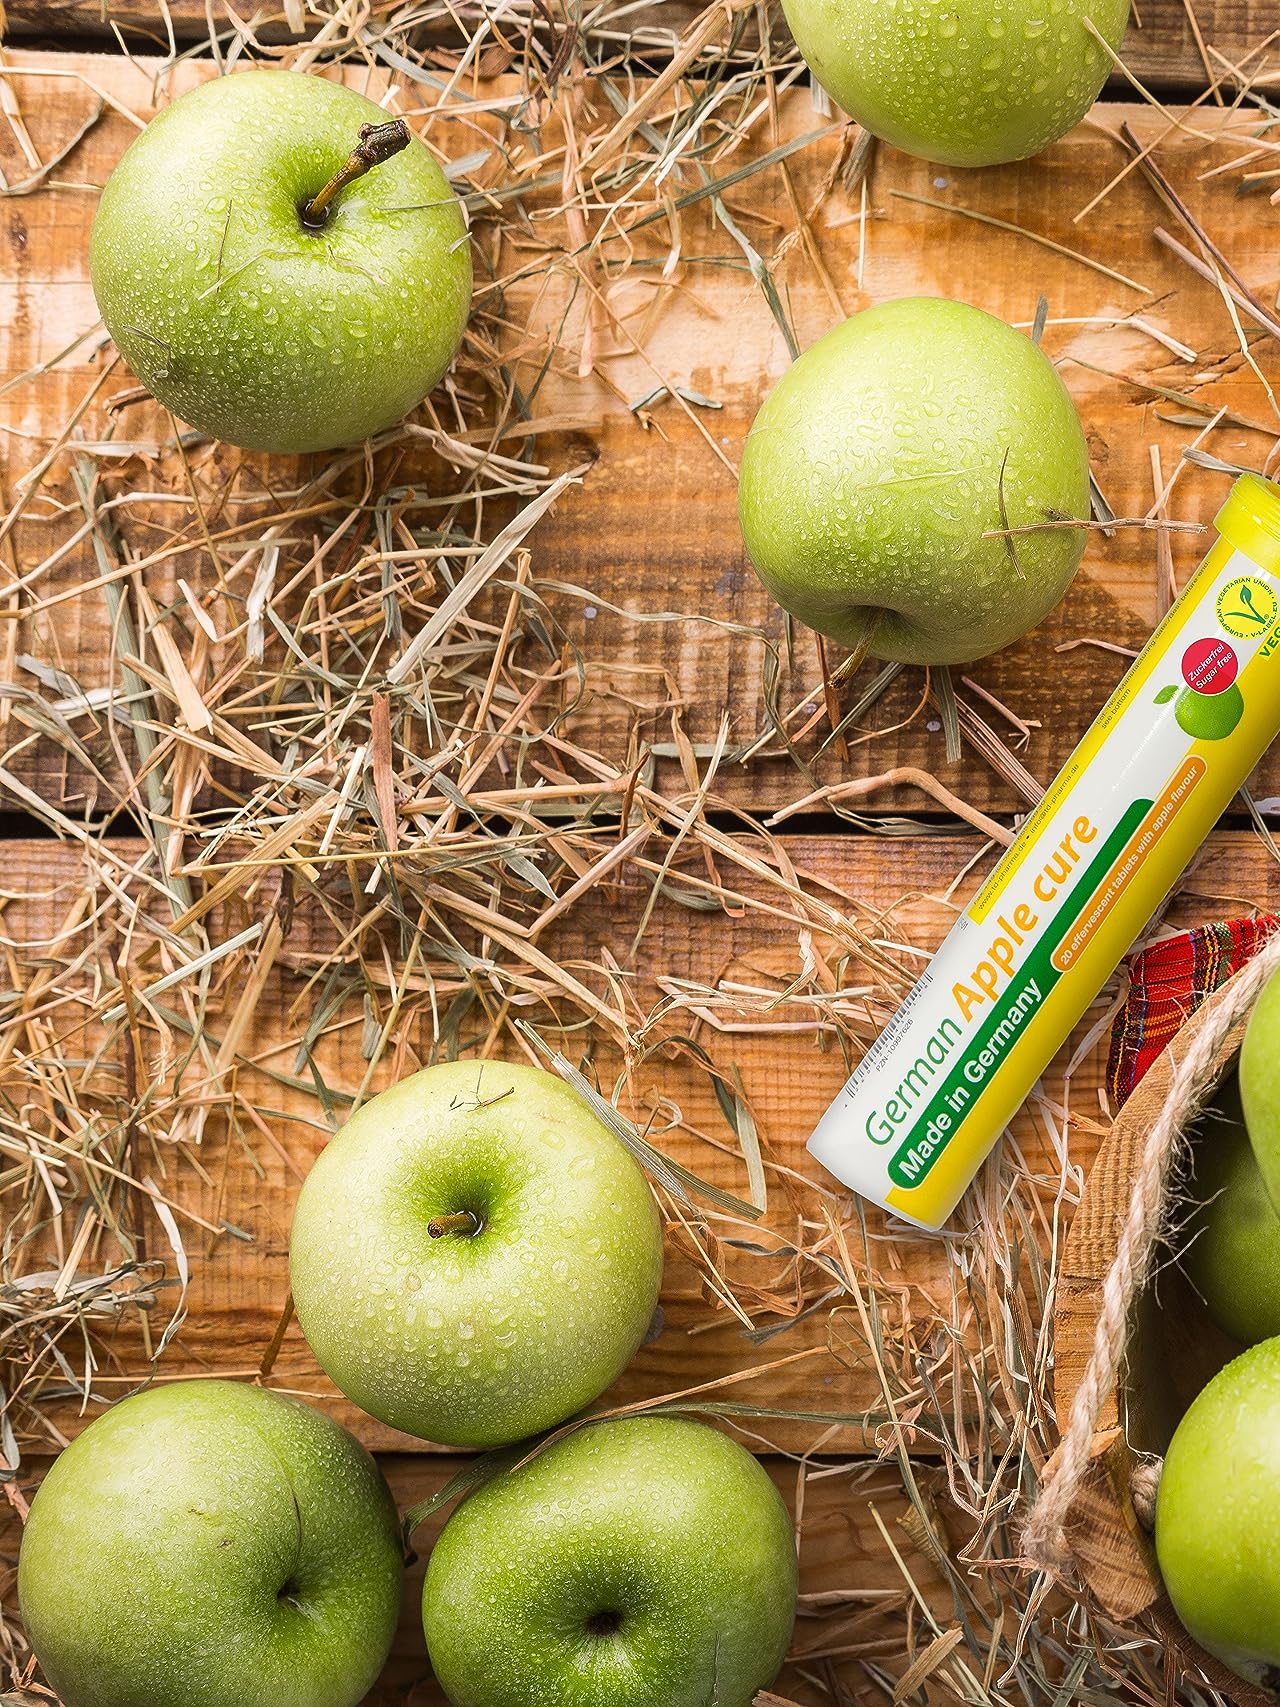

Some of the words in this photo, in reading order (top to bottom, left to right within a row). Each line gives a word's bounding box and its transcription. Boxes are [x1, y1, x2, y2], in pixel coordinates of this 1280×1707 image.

[1217, 577, 1251, 606] VEGETARIAN
[1253, 578, 1273, 596] UNION
[1216, 608, 1243, 638] EUROPEAN
[1251, 601, 1278, 638] V-LABEL.EU
[1188, 642, 1225, 682] Zuckerfrei
[1195, 664, 1218, 690] Sugar
[1217, 651, 1233, 669] free
[1109, 687, 1132, 715] bottom
[976, 839, 1028, 911] www.td-pharma.de
[1059, 949, 1073, 965] 20
[1068, 887, 1116, 950] effervescent
[1110, 852, 1139, 888] tablets
[1134, 828, 1154, 853] with
[1150, 802, 1175, 831] apple
[1168, 765, 1198, 802] flavour
[865, 1018, 962, 1145] German
[951, 903, 1038, 1022] Apple
[1033, 815, 1097, 902] cure
[875, 1018, 914, 1073] PZN-10997626
[898, 1113, 951, 1180] Made
[943, 1086, 970, 1112] in
[963, 977, 1041, 1082] Germany
